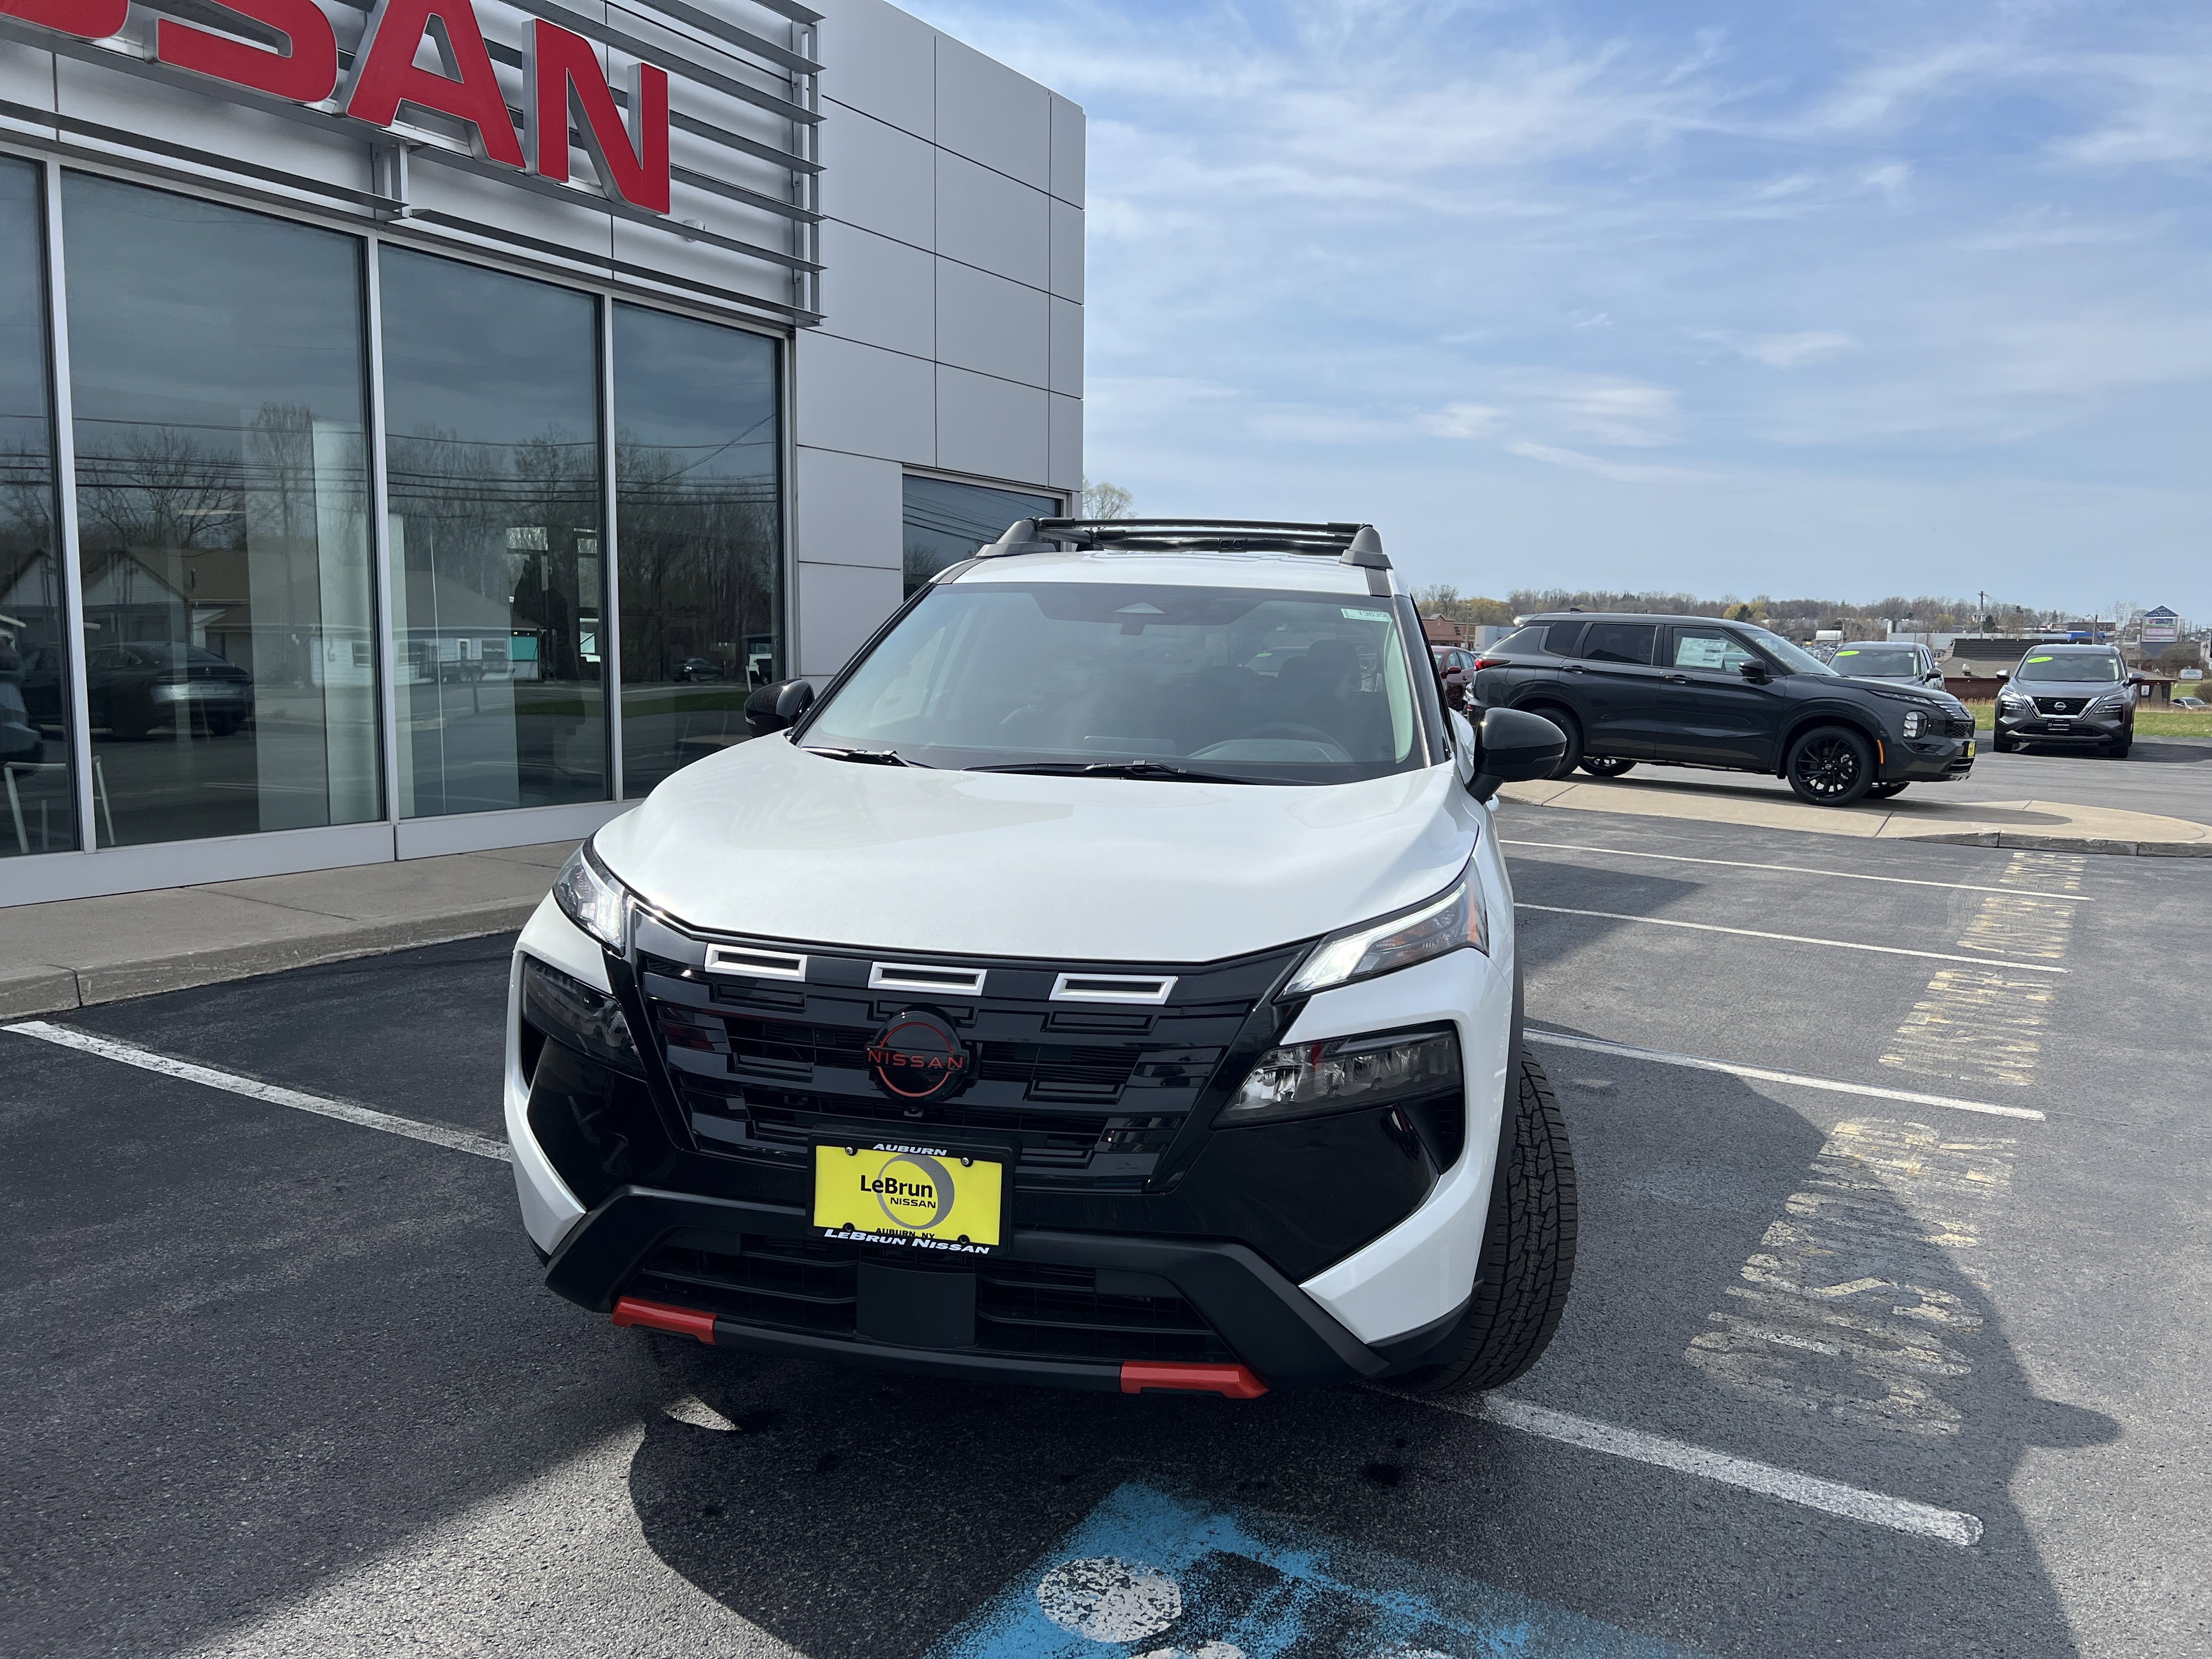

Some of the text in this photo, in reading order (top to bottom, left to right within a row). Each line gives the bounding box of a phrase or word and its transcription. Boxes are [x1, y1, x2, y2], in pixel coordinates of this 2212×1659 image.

[0, 0, 669, 215] SAN
[867, 1048, 964, 1069] NISSAN
[873, 1143, 947, 1156] AUBURN
[860, 1175, 933, 1198] LeBrun
[890, 1198, 936, 1209] NISSAN
[911, 1238, 990, 1254] NISSAN
